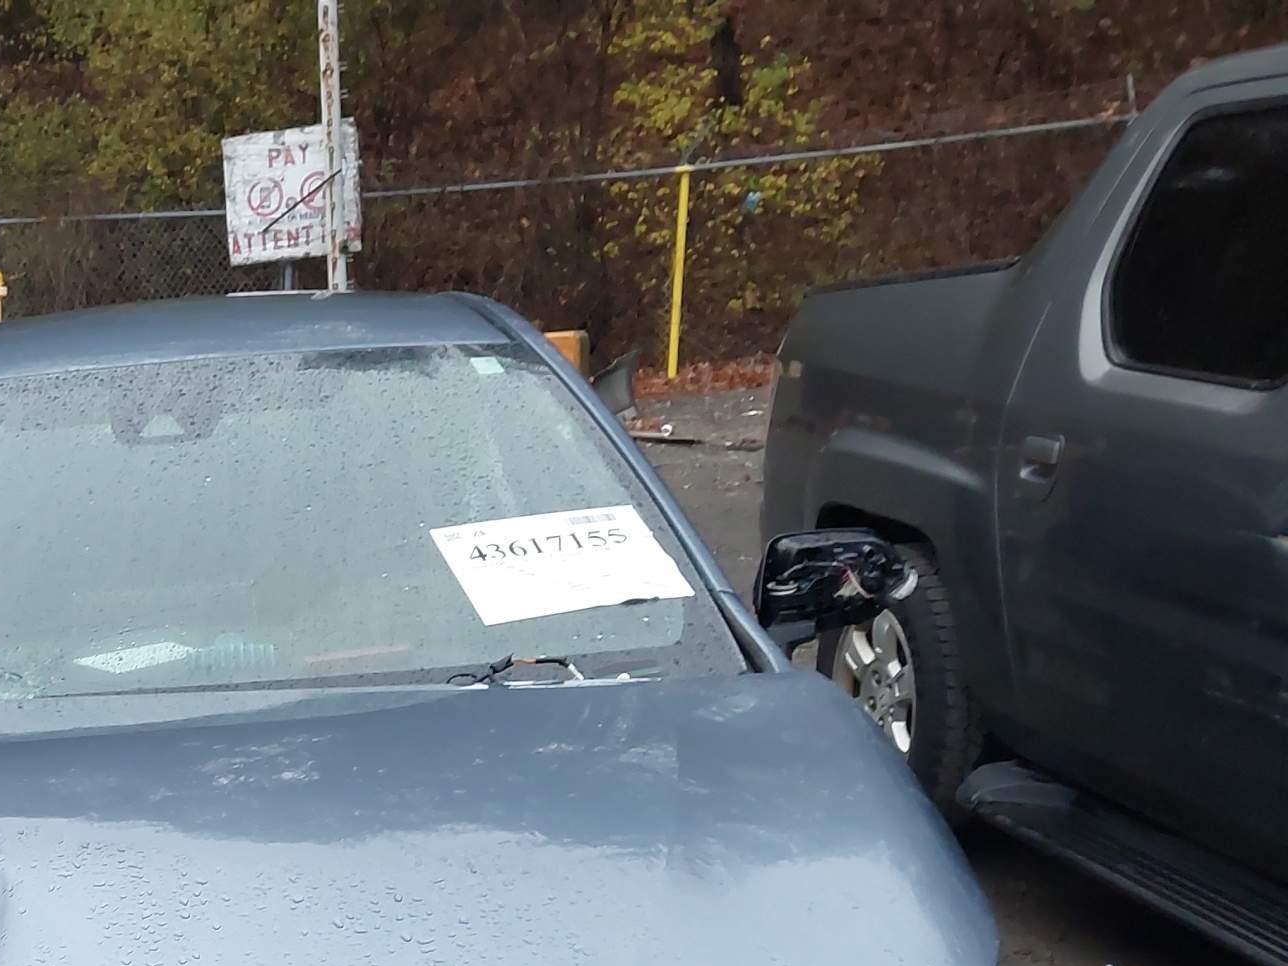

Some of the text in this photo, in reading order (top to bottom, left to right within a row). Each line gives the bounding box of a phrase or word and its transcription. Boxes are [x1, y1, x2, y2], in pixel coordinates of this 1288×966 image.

[267, 144, 309, 168] PAY
[231, 223, 362, 256] ATTENTI
[469, 528, 628, 562] 43617155
